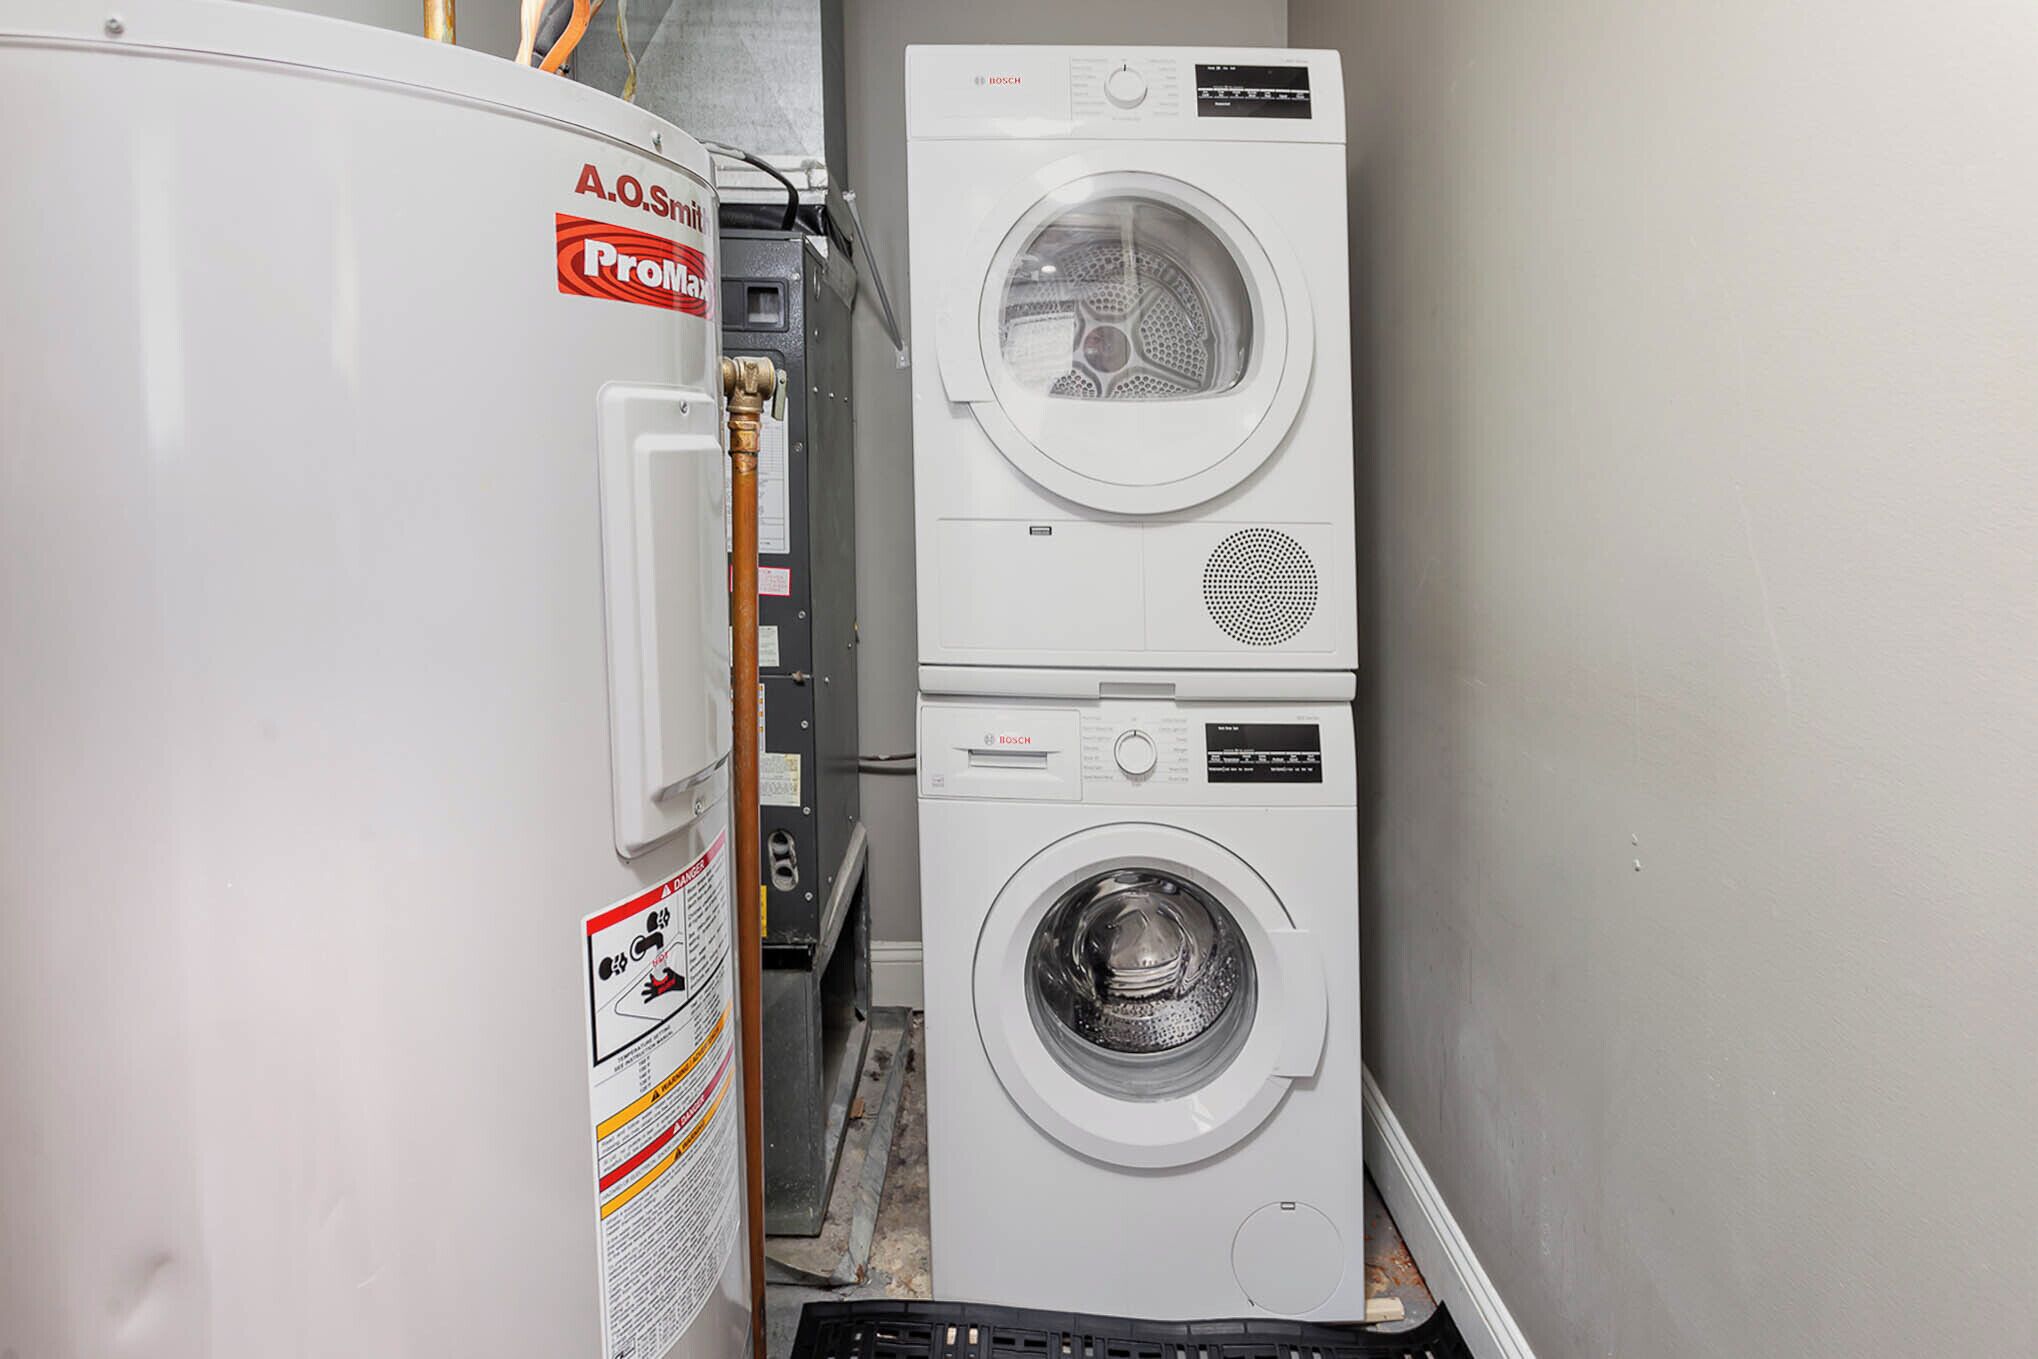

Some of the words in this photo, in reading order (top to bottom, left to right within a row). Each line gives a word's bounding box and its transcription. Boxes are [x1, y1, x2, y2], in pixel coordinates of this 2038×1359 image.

[989, 77, 1021, 85] BOSCH
[584, 238, 710, 302] ProMax
[999, 736, 1031, 744] BOSCH
[673, 859, 705, 890] DANGER
